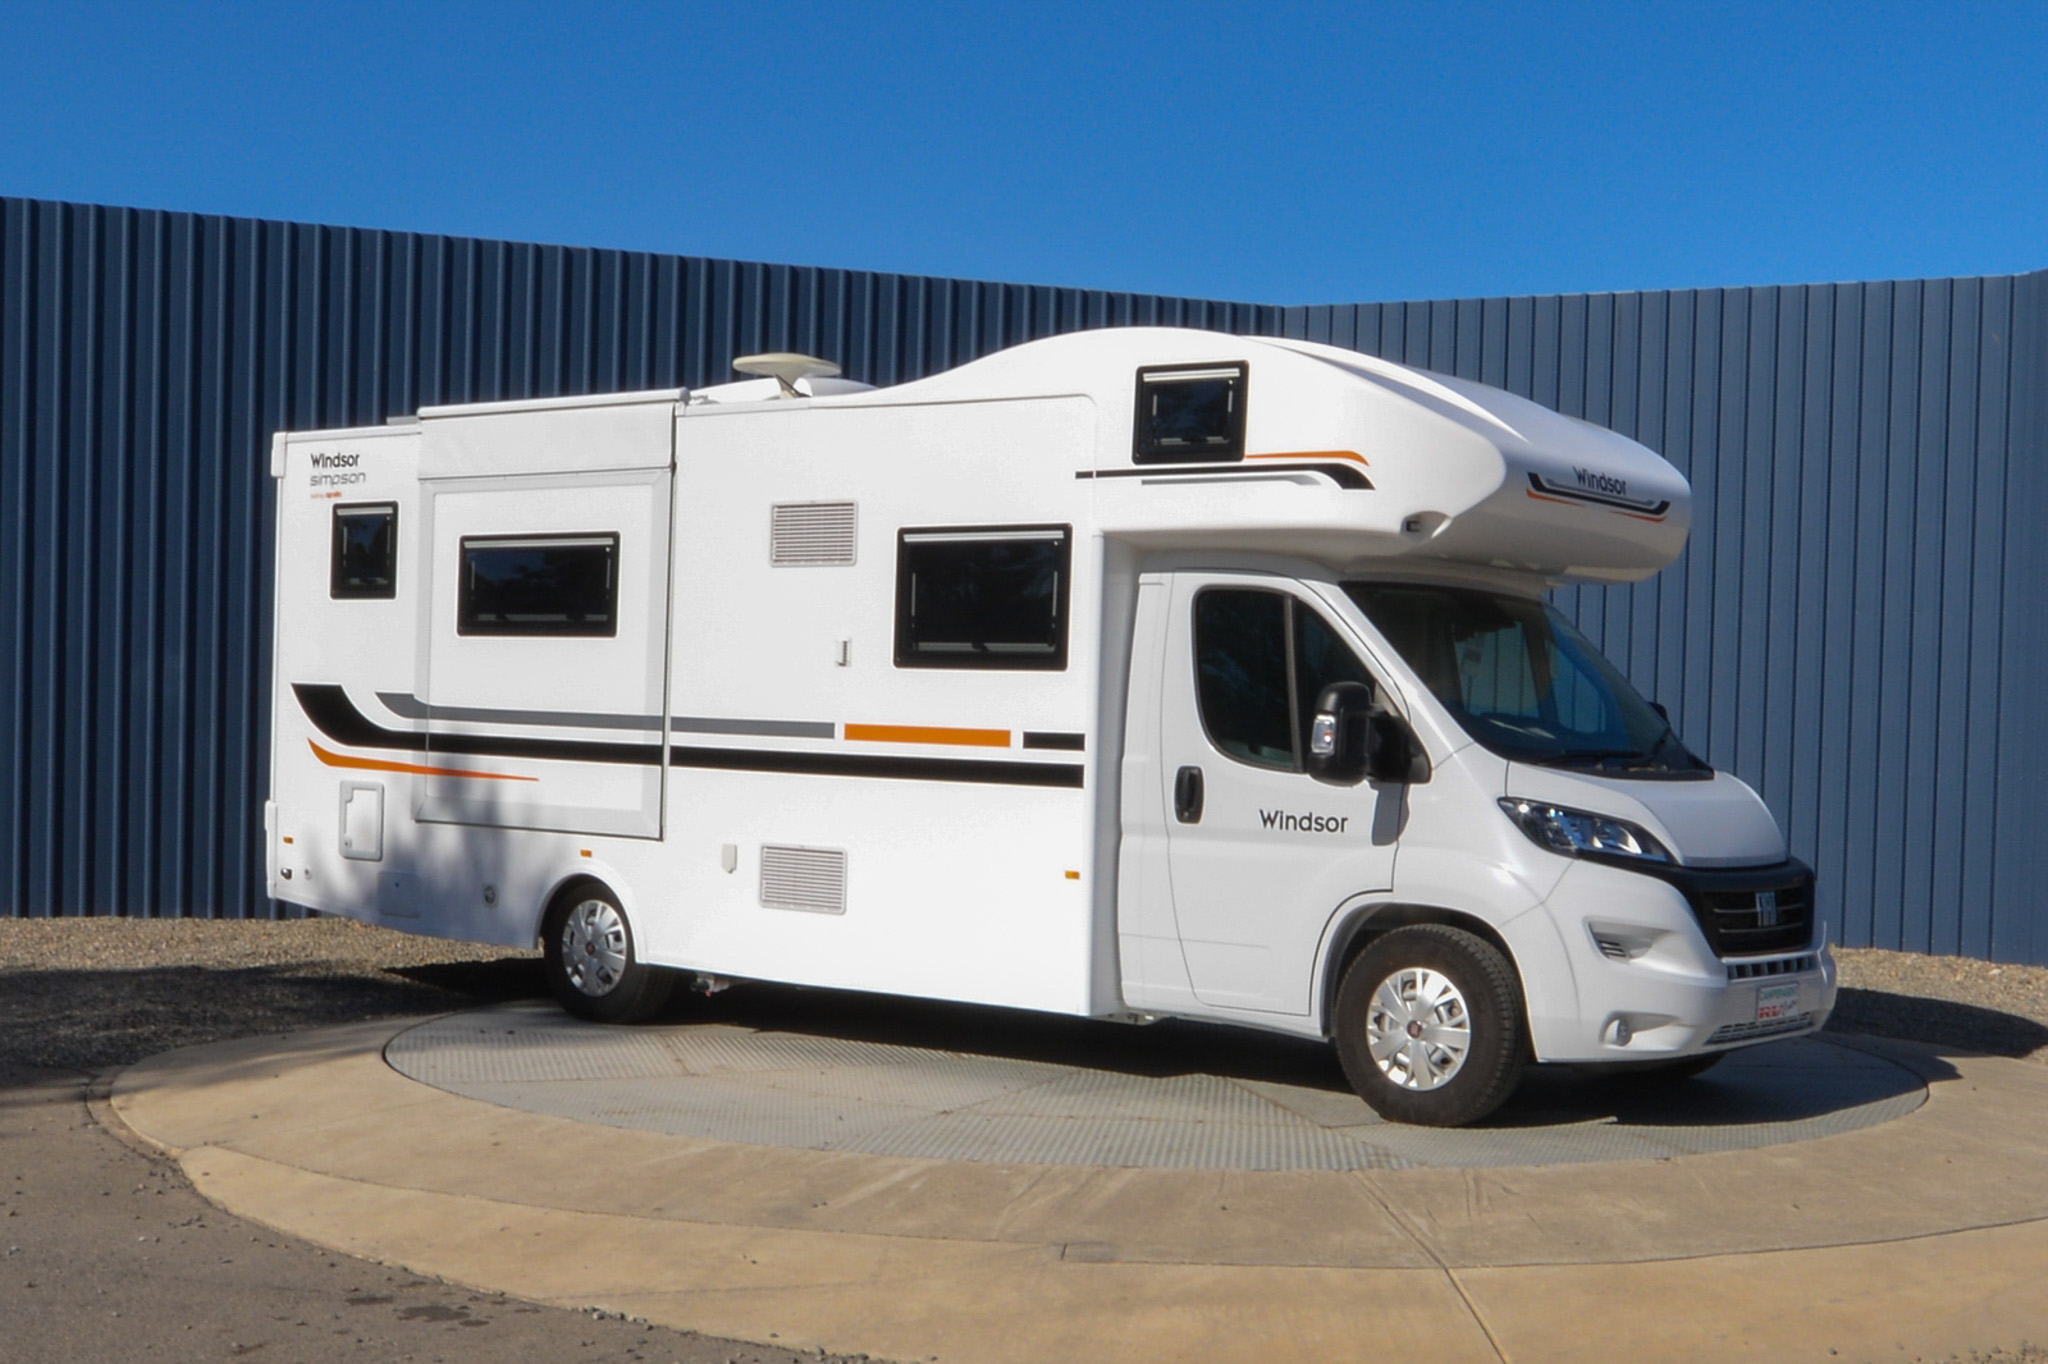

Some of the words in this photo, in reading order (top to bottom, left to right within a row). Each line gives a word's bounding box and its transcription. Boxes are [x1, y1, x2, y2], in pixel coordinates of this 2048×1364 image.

[310, 452, 360, 469] Windsor
[310, 471, 366, 487] simpson
[1572, 466, 1627, 496] Windsor
[1258, 808, 1349, 833] Windsor
